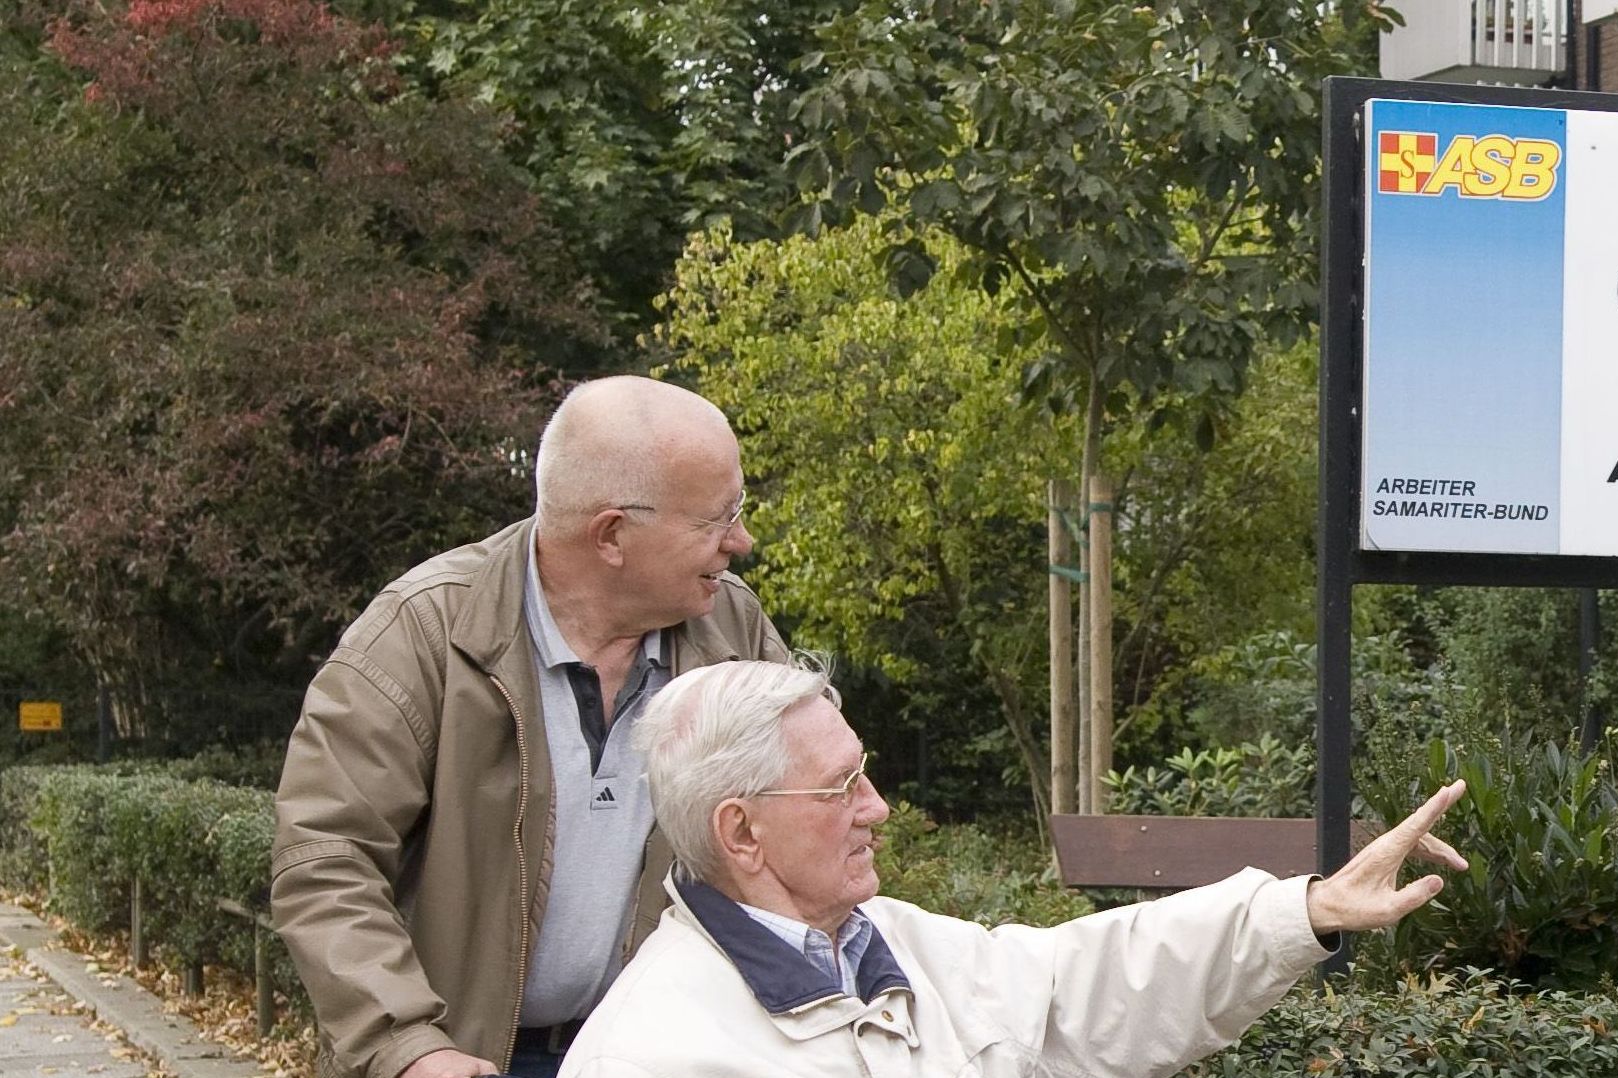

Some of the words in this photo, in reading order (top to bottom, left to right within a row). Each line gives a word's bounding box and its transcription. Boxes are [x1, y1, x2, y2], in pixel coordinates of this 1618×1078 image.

[1422, 135, 1560, 200] ASB
[1376, 478, 1476, 496] ARBEITER
[1373, 500, 1549, 521] SAMARITER-BUND
